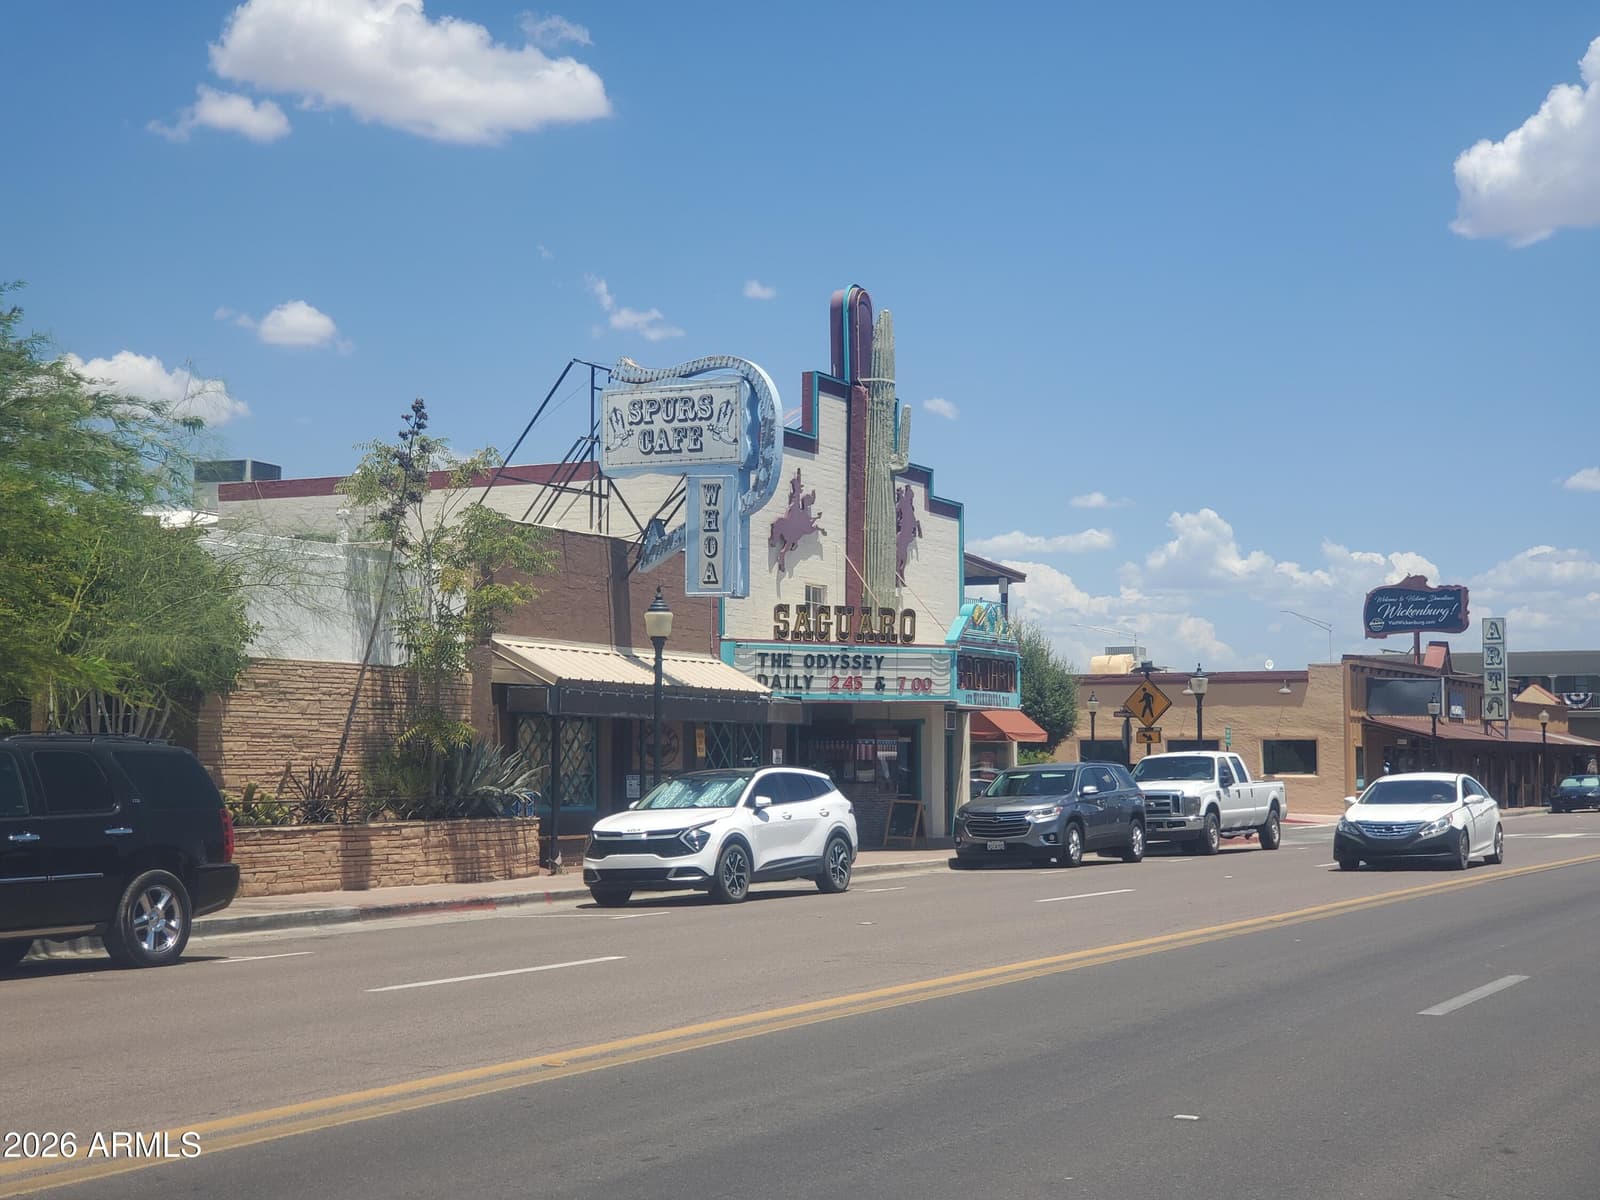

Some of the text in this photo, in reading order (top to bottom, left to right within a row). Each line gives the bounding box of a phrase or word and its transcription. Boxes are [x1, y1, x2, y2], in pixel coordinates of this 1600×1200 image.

[628, 393, 714, 425] SPURS
[638, 424, 704, 456] CAFE
[702, 483, 721, 584] WHOA
[773, 603, 916, 644] SAGUARO
[1377, 602, 1458, 622] Wickenburg!
[757, 652, 885, 670] THE ODYSSEY
[757, 674, 815, 691] DAILY
[875, 676, 886, 691] &
